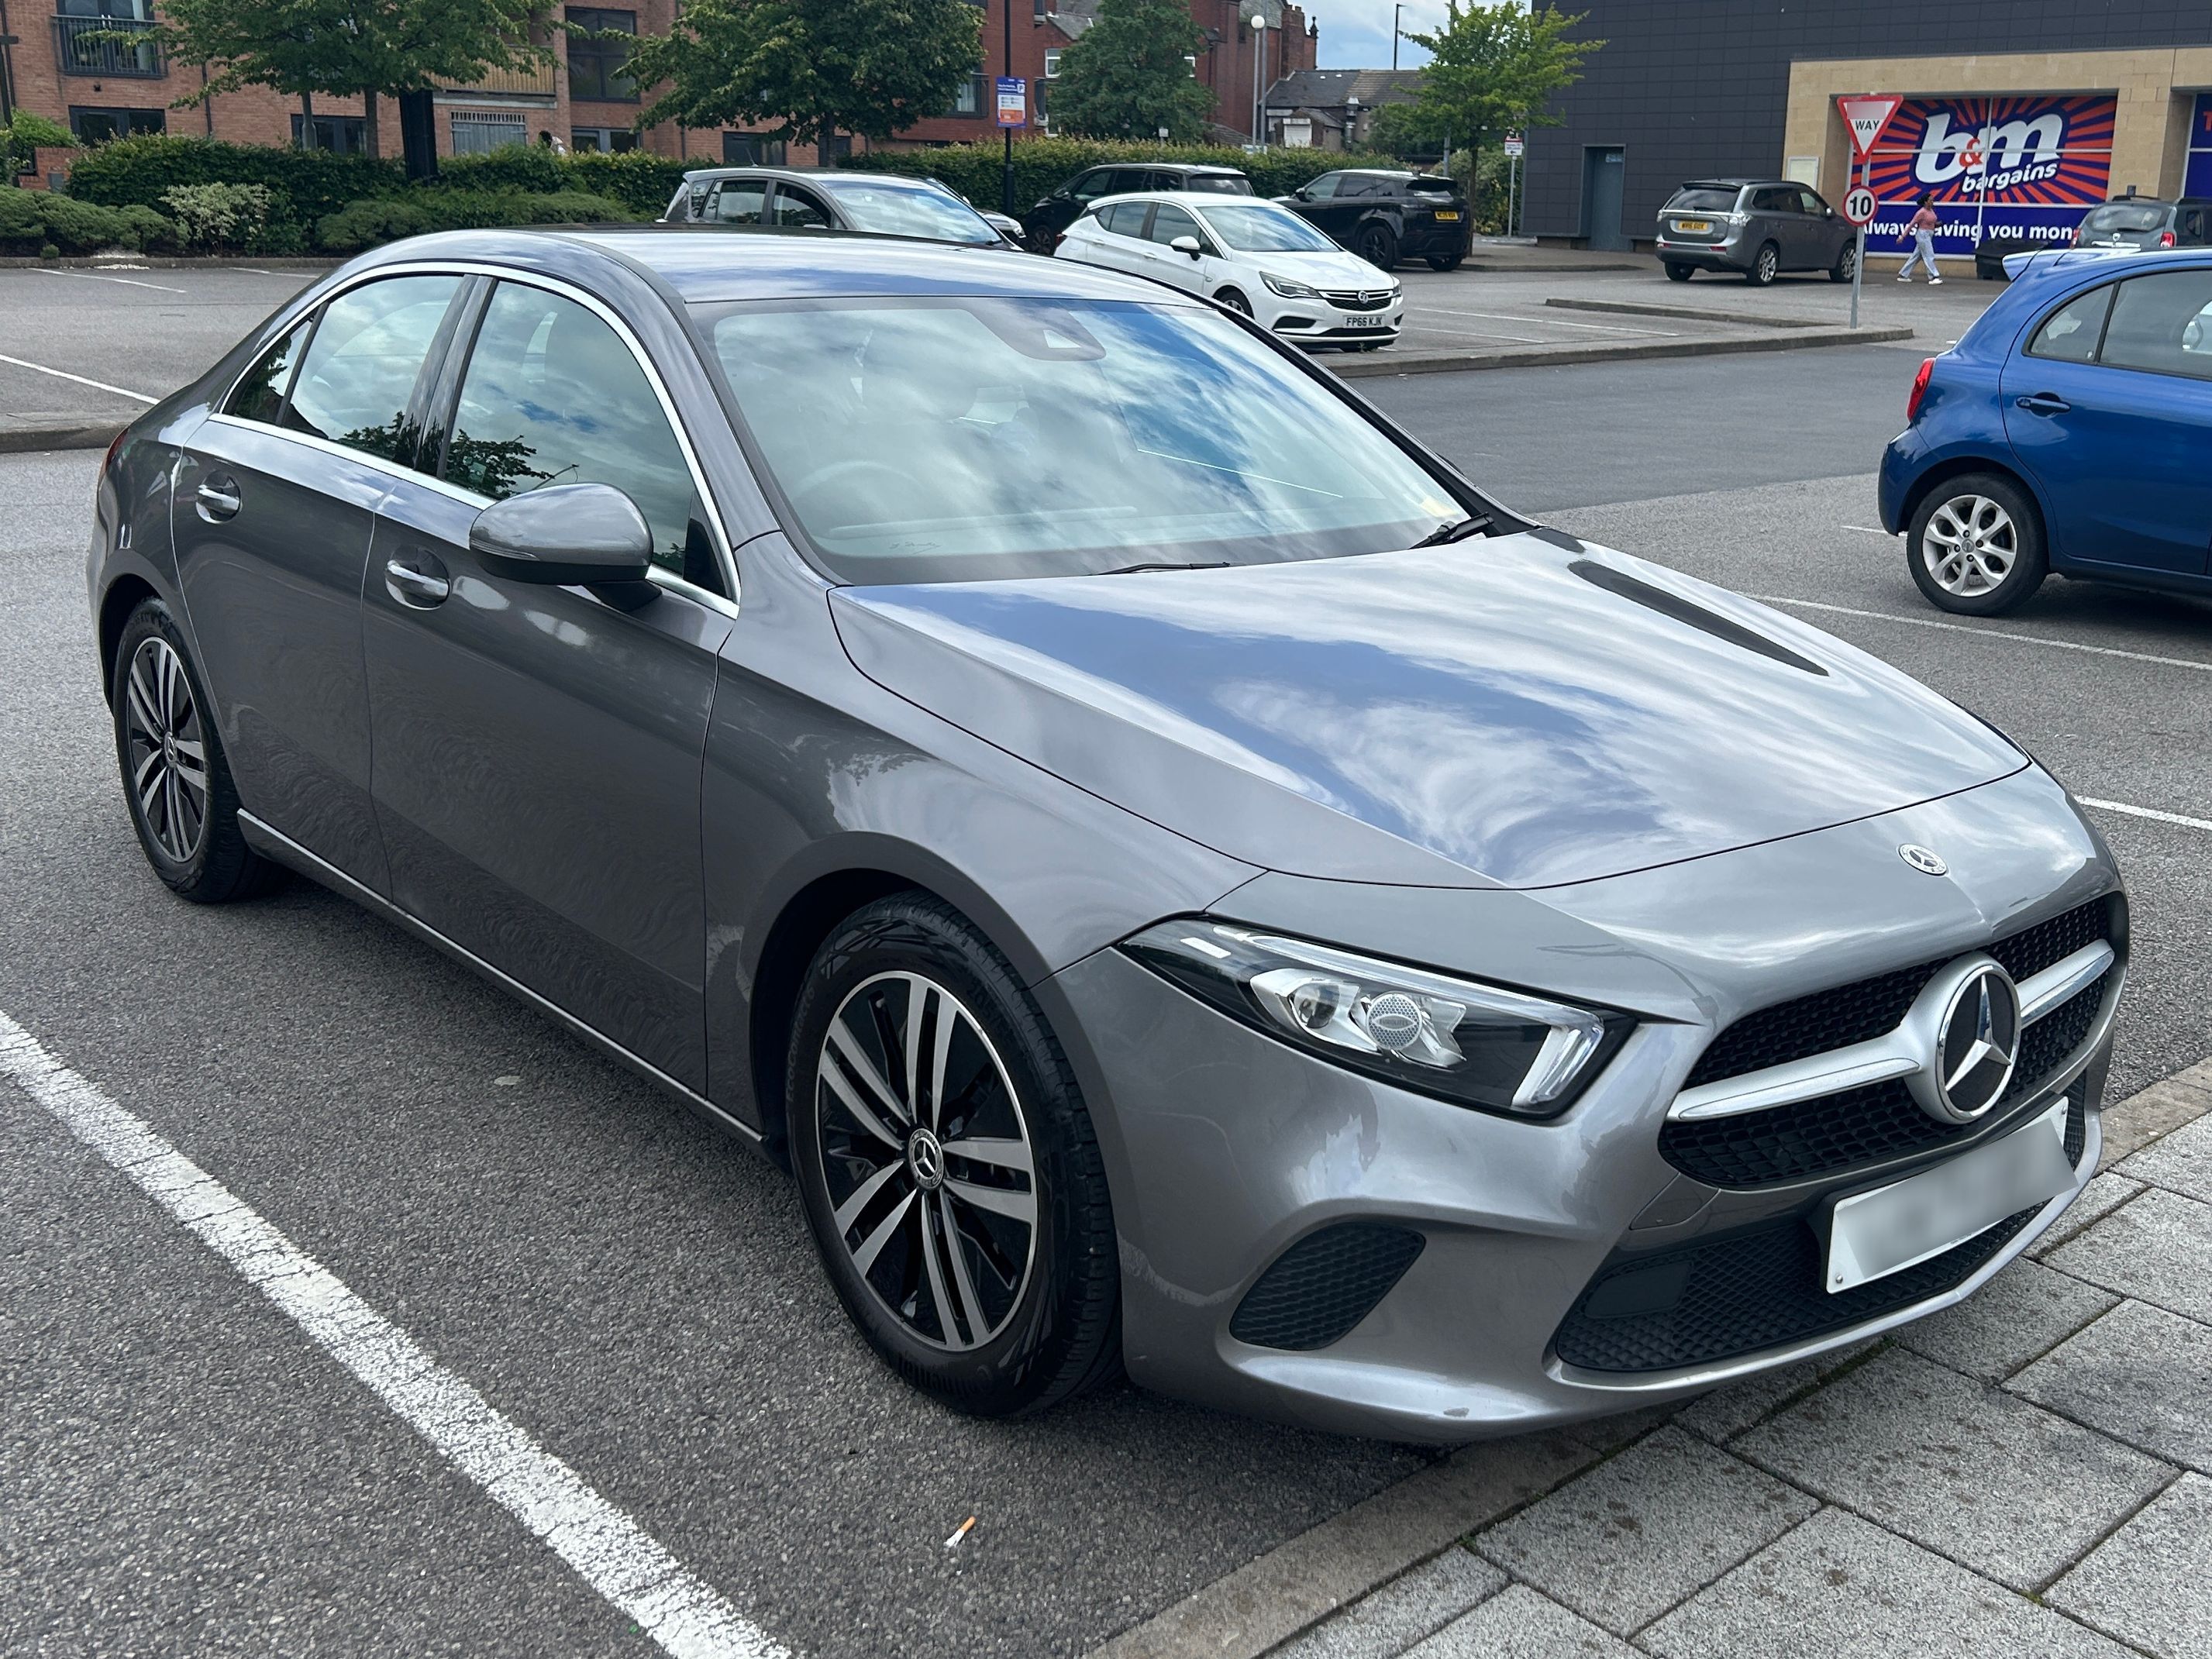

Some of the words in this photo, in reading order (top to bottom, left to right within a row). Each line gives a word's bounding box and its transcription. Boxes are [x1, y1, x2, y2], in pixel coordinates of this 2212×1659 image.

[1855, 120, 1880, 130] WAY
[1915, 112, 2061, 184] b&m
[1962, 163, 2058, 193] bargains
[1849, 196, 1872, 216] 10
[1935, 219, 1983, 241] aving
[1989, 225, 2024, 239] you
[2028, 225, 2073, 240] mon
[1346, 317, 1367, 326] FP66
